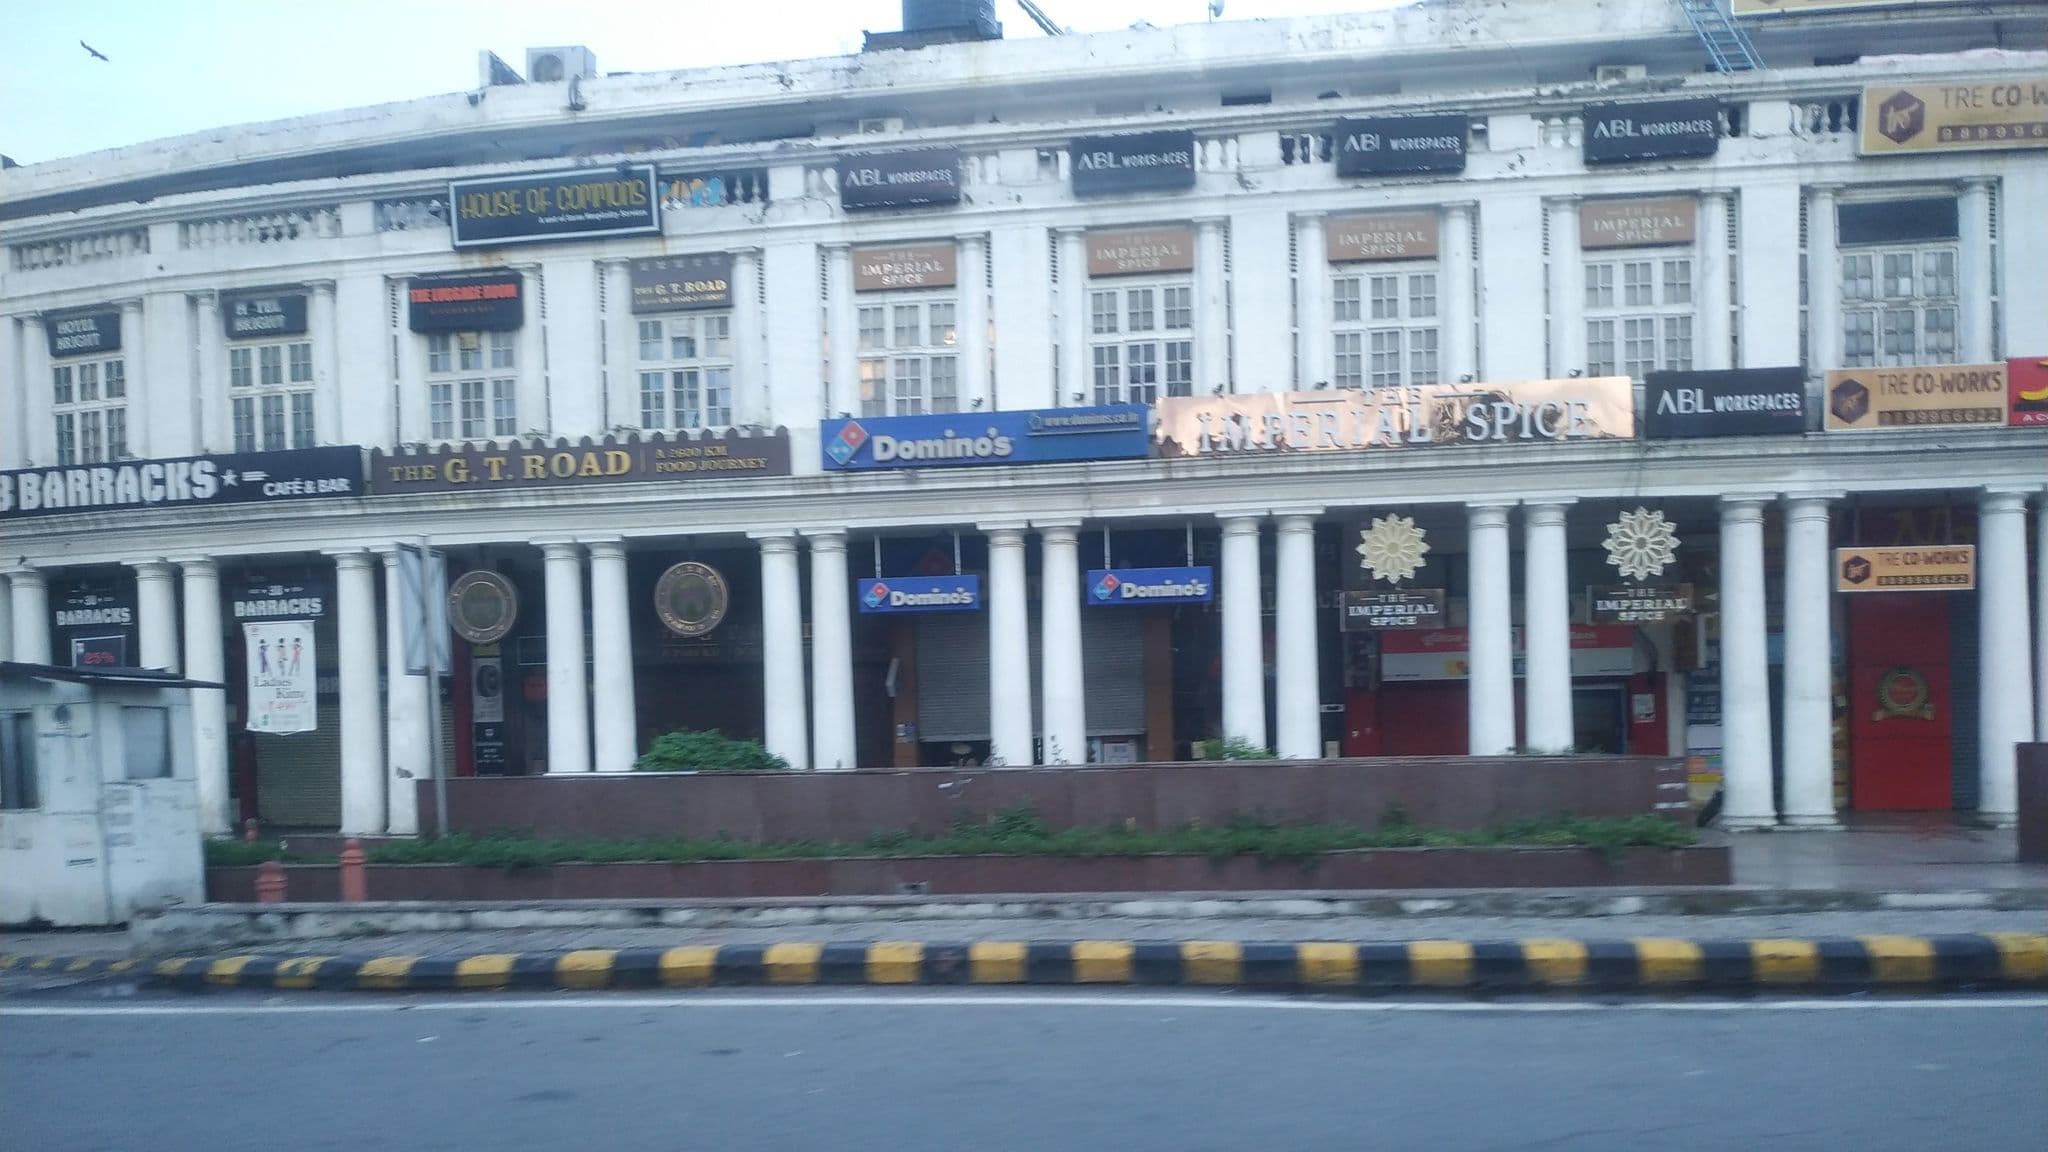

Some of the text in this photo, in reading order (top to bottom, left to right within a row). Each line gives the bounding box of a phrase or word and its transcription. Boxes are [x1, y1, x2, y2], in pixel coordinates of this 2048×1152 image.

[1940, 87, 1984, 109] TRE
[1592, 118, 1715, 139] ABL WORKSPACES
[1389, 136, 1460, 151] WORKSPACES
[1078, 151, 1122, 170] ABL
[845, 168, 888, 188] ABL
[460, 189, 522, 219] HOUSE
[526, 186, 551, 215] OF
[1592, 215, 1685, 232] IMPERIAL
[1337, 230, 1428, 246] IMPERIAL
[1615, 229, 1664, 241] SPICE
[1096, 244, 1182, 260] IMPERIAL
[1360, 243, 1408, 256] SPICE
[861, 260, 945, 276] IMPERIAL
[1115, 257, 1161, 270] SPICE
[684, 279, 728, 294] ROAD
[881, 273, 925, 286] SPICE
[1878, 370, 2001, 396] TRE CO-WORKS
[1656, 388, 1801, 415] ABL WORKSPACES
[1199, 399, 1592, 453] IMPERIAL SPICE
[872, 426, 1013, 462] Domino's
[388, 464, 436, 482] THE
[522, 450, 632, 480] ROAD
[655, 457, 769, 473] FOOD JOURNEY
[18, 459, 218, 511] BARRACKS
[303, 480, 317, 494] &
[317, 477, 352, 493] BAR
[889, 586, 975, 607] Domino's
[1120, 578, 1208, 598] Domino's
[234, 597, 323, 617] BARRACKS
[1348, 603, 1439, 616] IMPERIAL
[1596, 598, 1688, 611] IMPERIAL
[56, 607, 132, 626] BARRACKS
[1369, 616, 1417, 626] SPICE
[1618, 611, 1665, 621] SPICE
